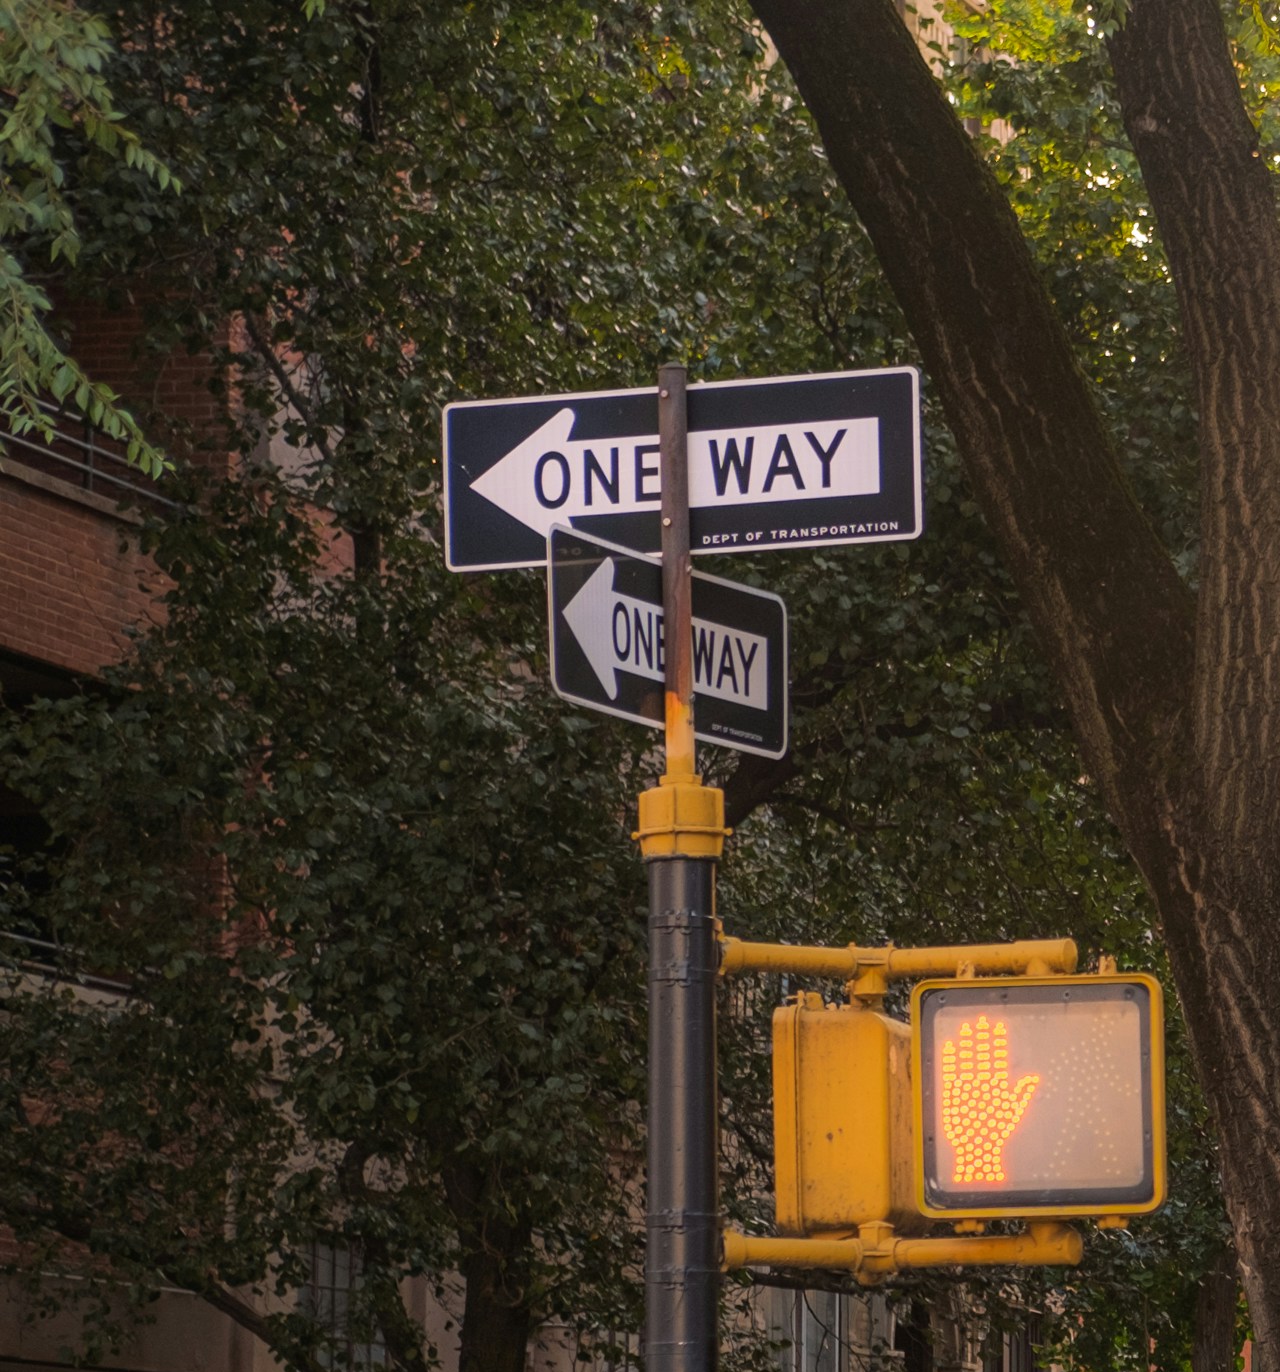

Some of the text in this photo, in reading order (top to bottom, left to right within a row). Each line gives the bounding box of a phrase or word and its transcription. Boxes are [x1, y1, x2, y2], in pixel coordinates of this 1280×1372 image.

[533, 428, 848, 510] ONE WAY
[702, 521, 899, 545] DEPT OF TRANSPORTATION
[612, 601, 759, 698] ONE WAY
